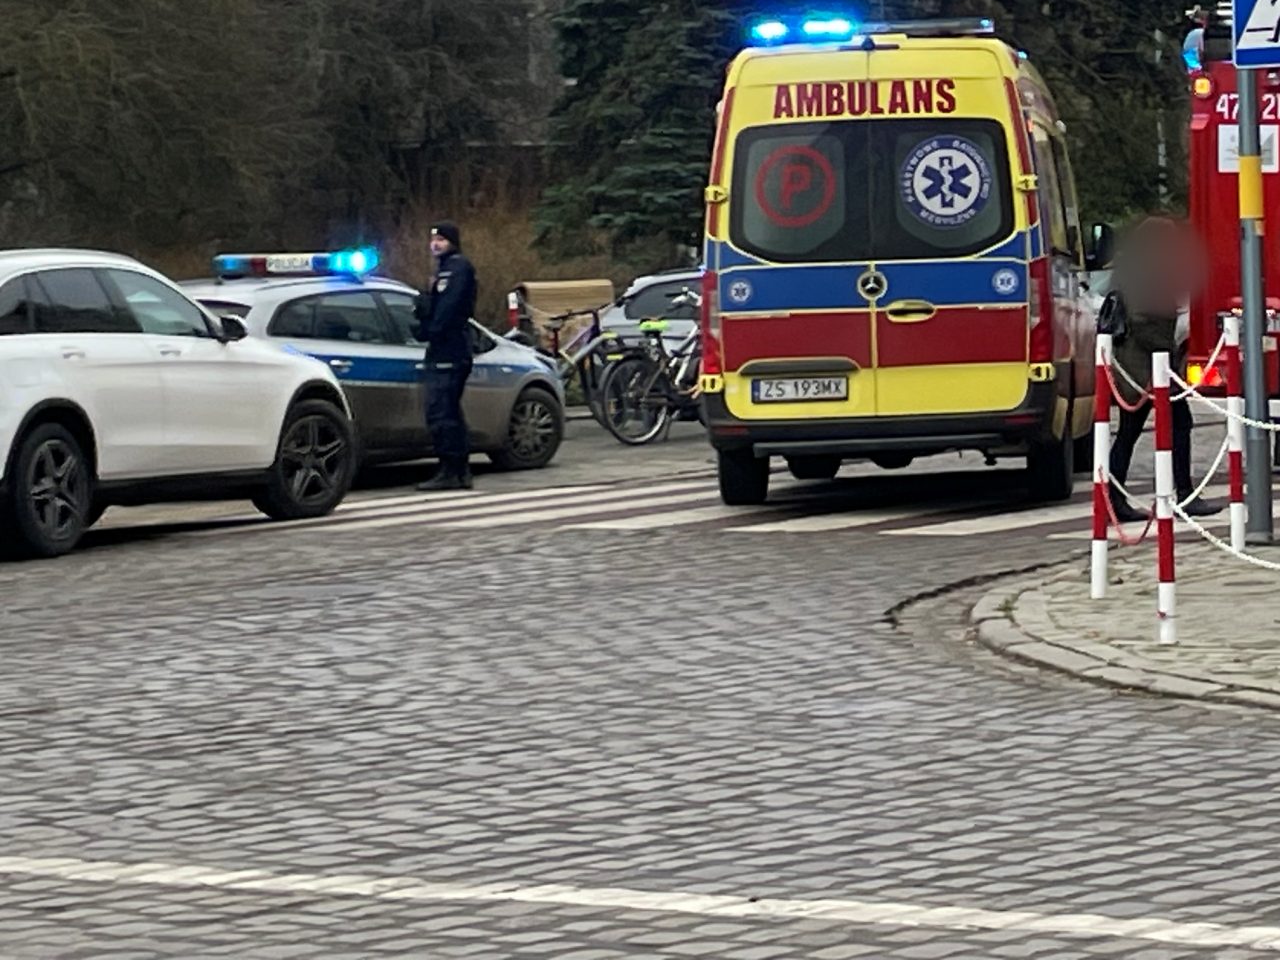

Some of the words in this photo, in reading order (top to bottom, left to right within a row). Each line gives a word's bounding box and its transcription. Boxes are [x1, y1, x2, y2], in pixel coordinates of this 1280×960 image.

[773, 78, 957, 119] AMBULANS
[763, 380, 786, 398] ZS
[793, 378, 842, 397] 193MX
